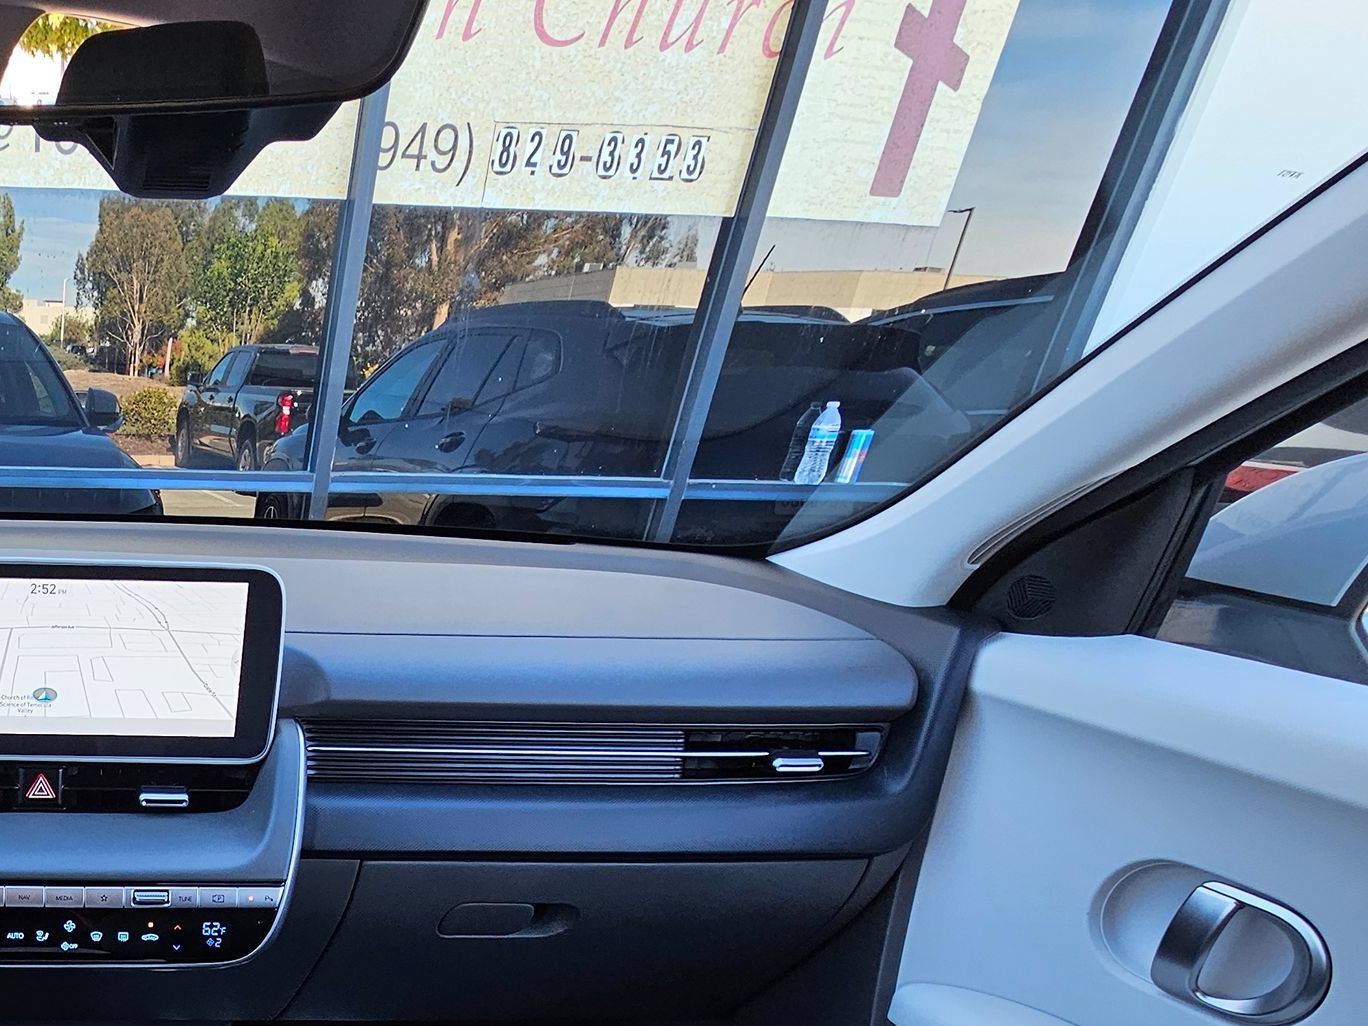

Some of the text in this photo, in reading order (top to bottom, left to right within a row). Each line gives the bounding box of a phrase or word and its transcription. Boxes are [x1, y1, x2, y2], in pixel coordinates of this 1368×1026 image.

[377, 121, 475, 187] 949)
[491, 126, 710, 182] 829-3353
[29, 582, 57, 595] 2:52
[6, 931, 25, 940] AUTO
